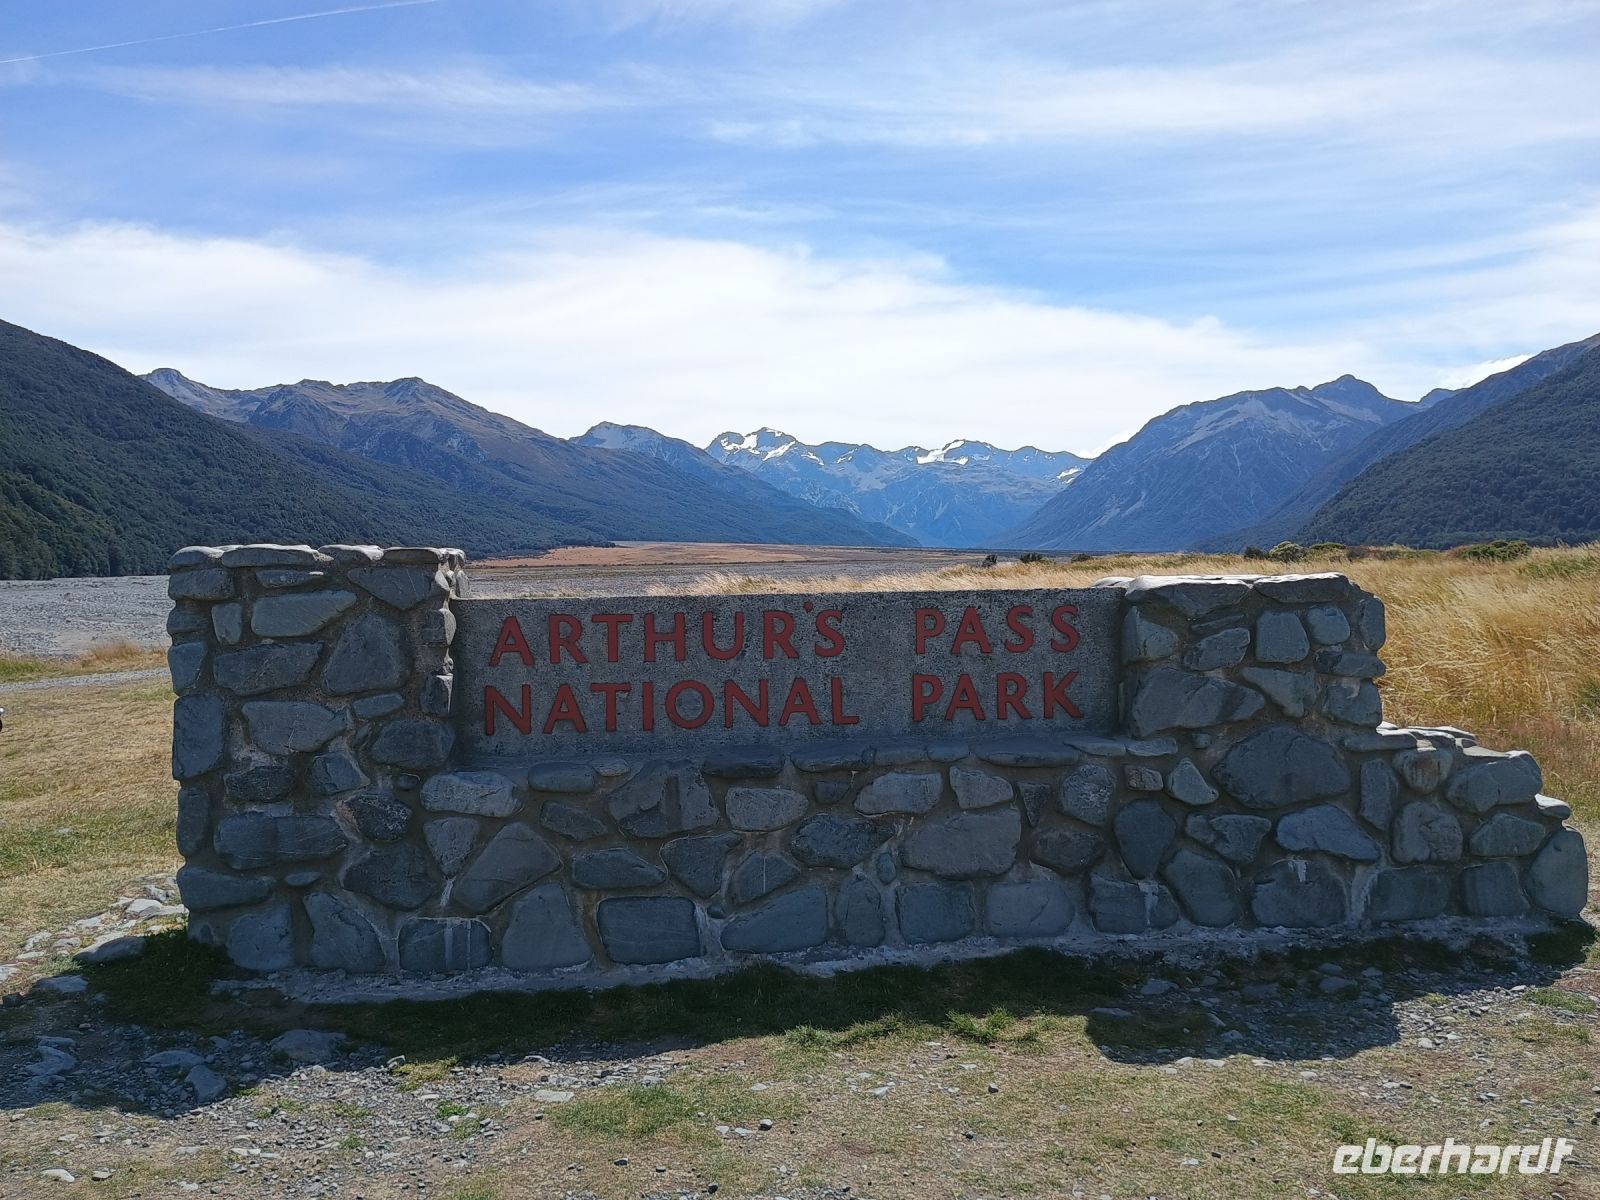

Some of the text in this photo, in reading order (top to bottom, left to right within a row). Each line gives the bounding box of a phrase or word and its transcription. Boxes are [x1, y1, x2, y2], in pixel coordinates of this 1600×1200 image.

[490, 602, 1080, 666] ARTHUR'S PASS
[484, 671, 1083, 734] NATIONAL PARK
